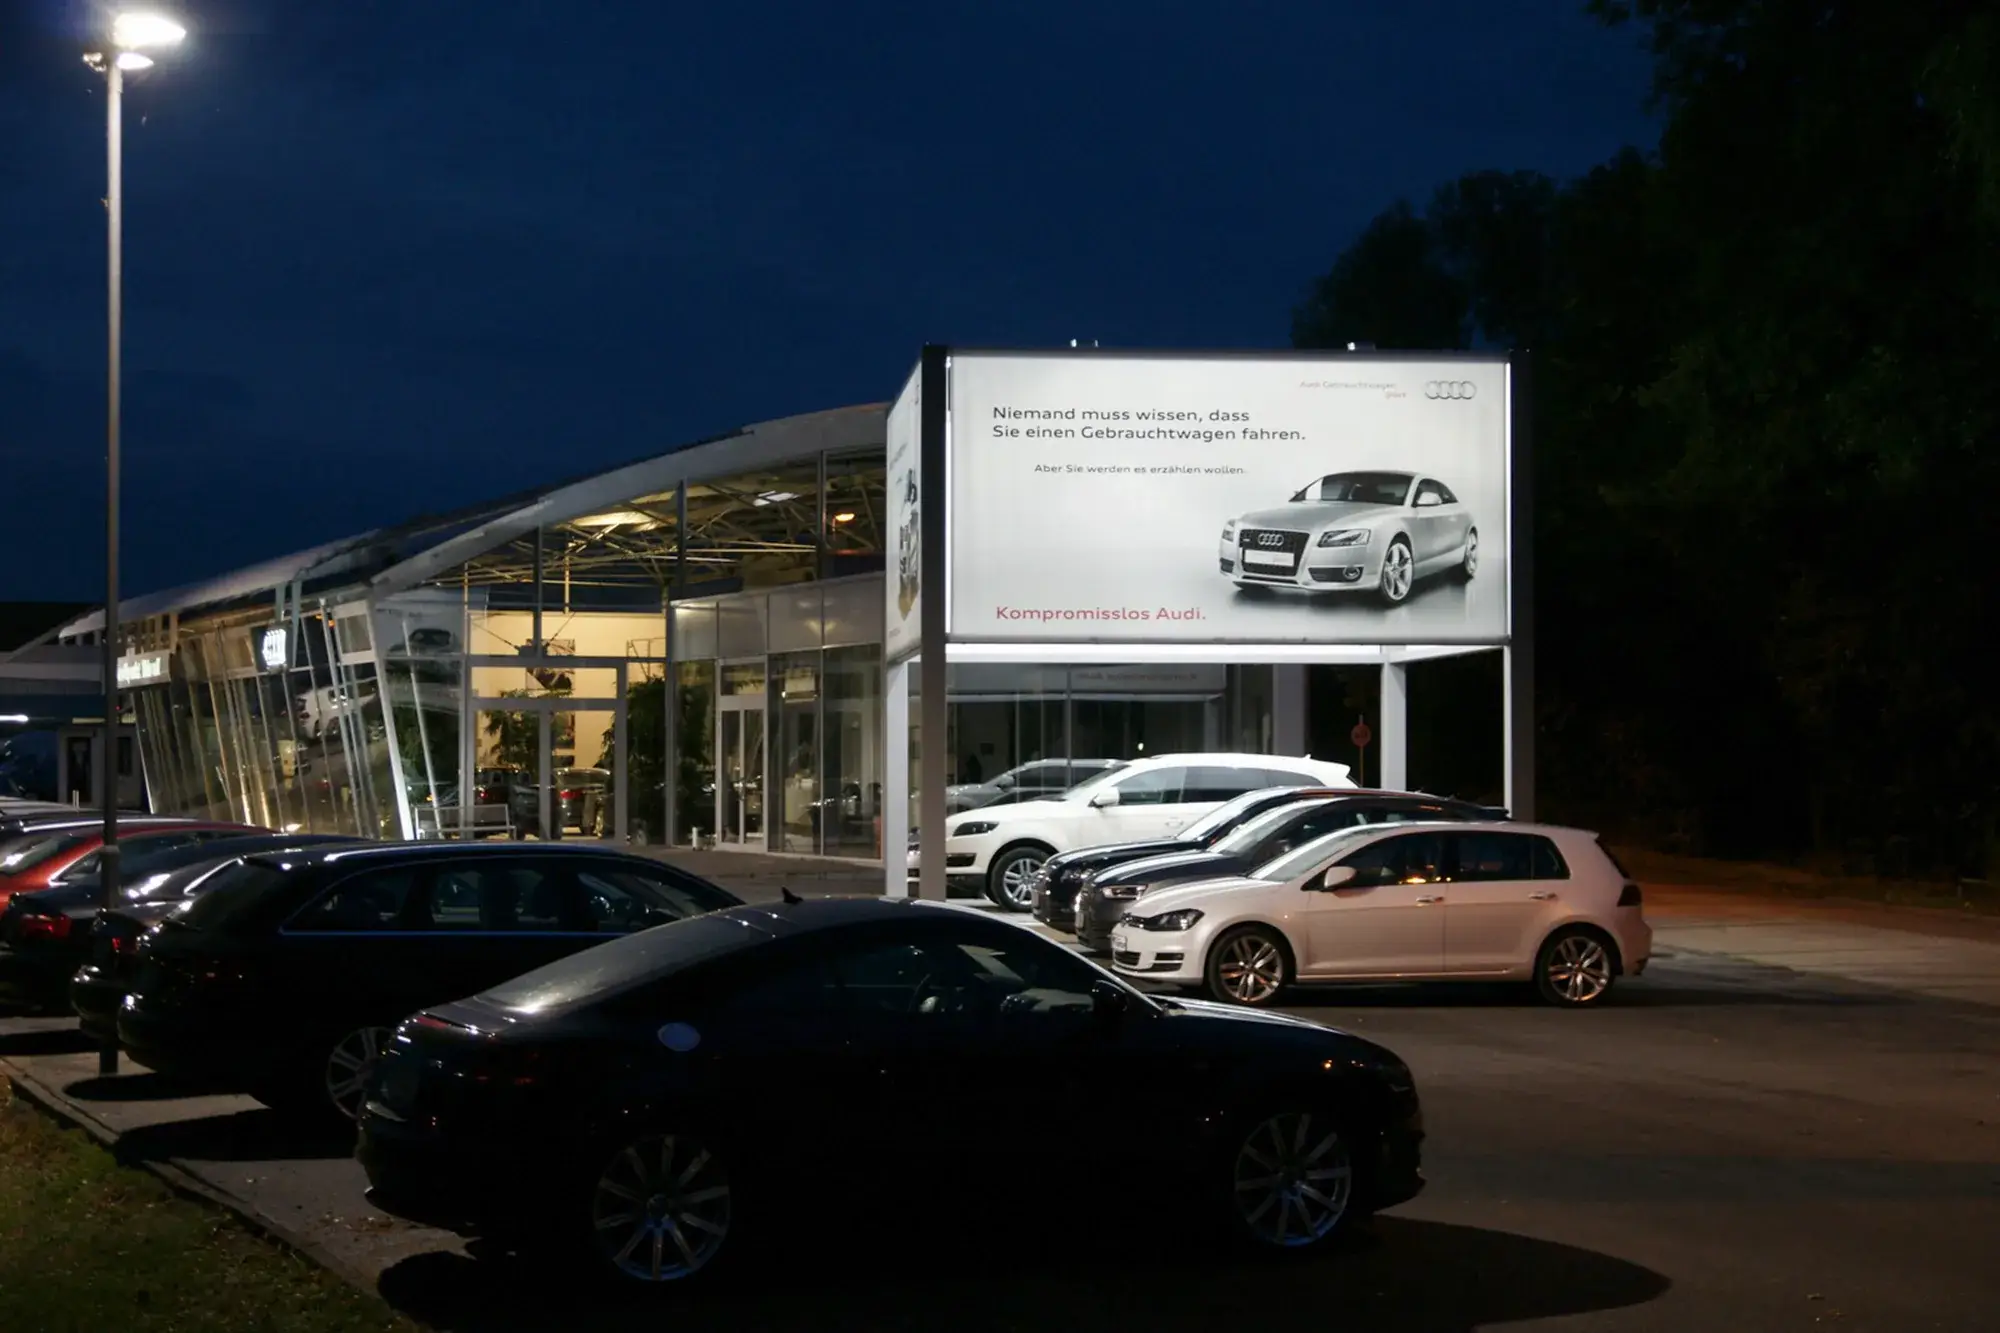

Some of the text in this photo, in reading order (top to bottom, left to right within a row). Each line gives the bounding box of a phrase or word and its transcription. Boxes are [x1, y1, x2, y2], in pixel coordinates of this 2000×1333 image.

[993, 407, 1250, 423] Niemand muss wissen, dass
[992, 424, 1306, 443] Sie einen Gebrauchtwagen fahren.
[1034, 464, 1063, 474] Aber
[1065, 464, 1084, 474] Sie
[1087, 465, 1131, 474] werden
[1134, 466, 1148, 474] es
[1149, 465, 1201, 475] erzählen
[996, 606, 1207, 623] Kompromisslos Audi.
